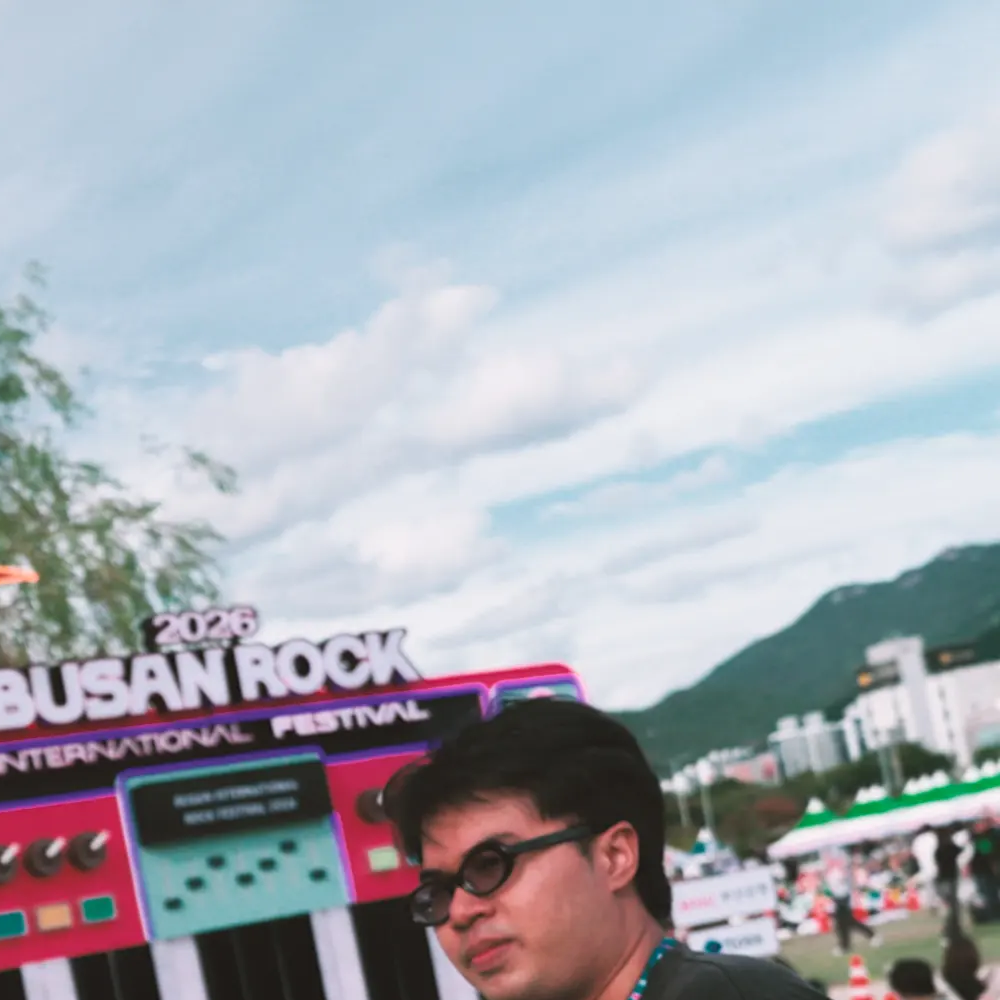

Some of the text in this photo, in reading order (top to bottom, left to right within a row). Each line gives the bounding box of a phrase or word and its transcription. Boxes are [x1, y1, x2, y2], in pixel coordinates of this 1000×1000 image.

[152, 608, 257, 646] 2026
[233, 629, 422, 701] ROCK
[270, 699, 431, 739] FESTIVAL
